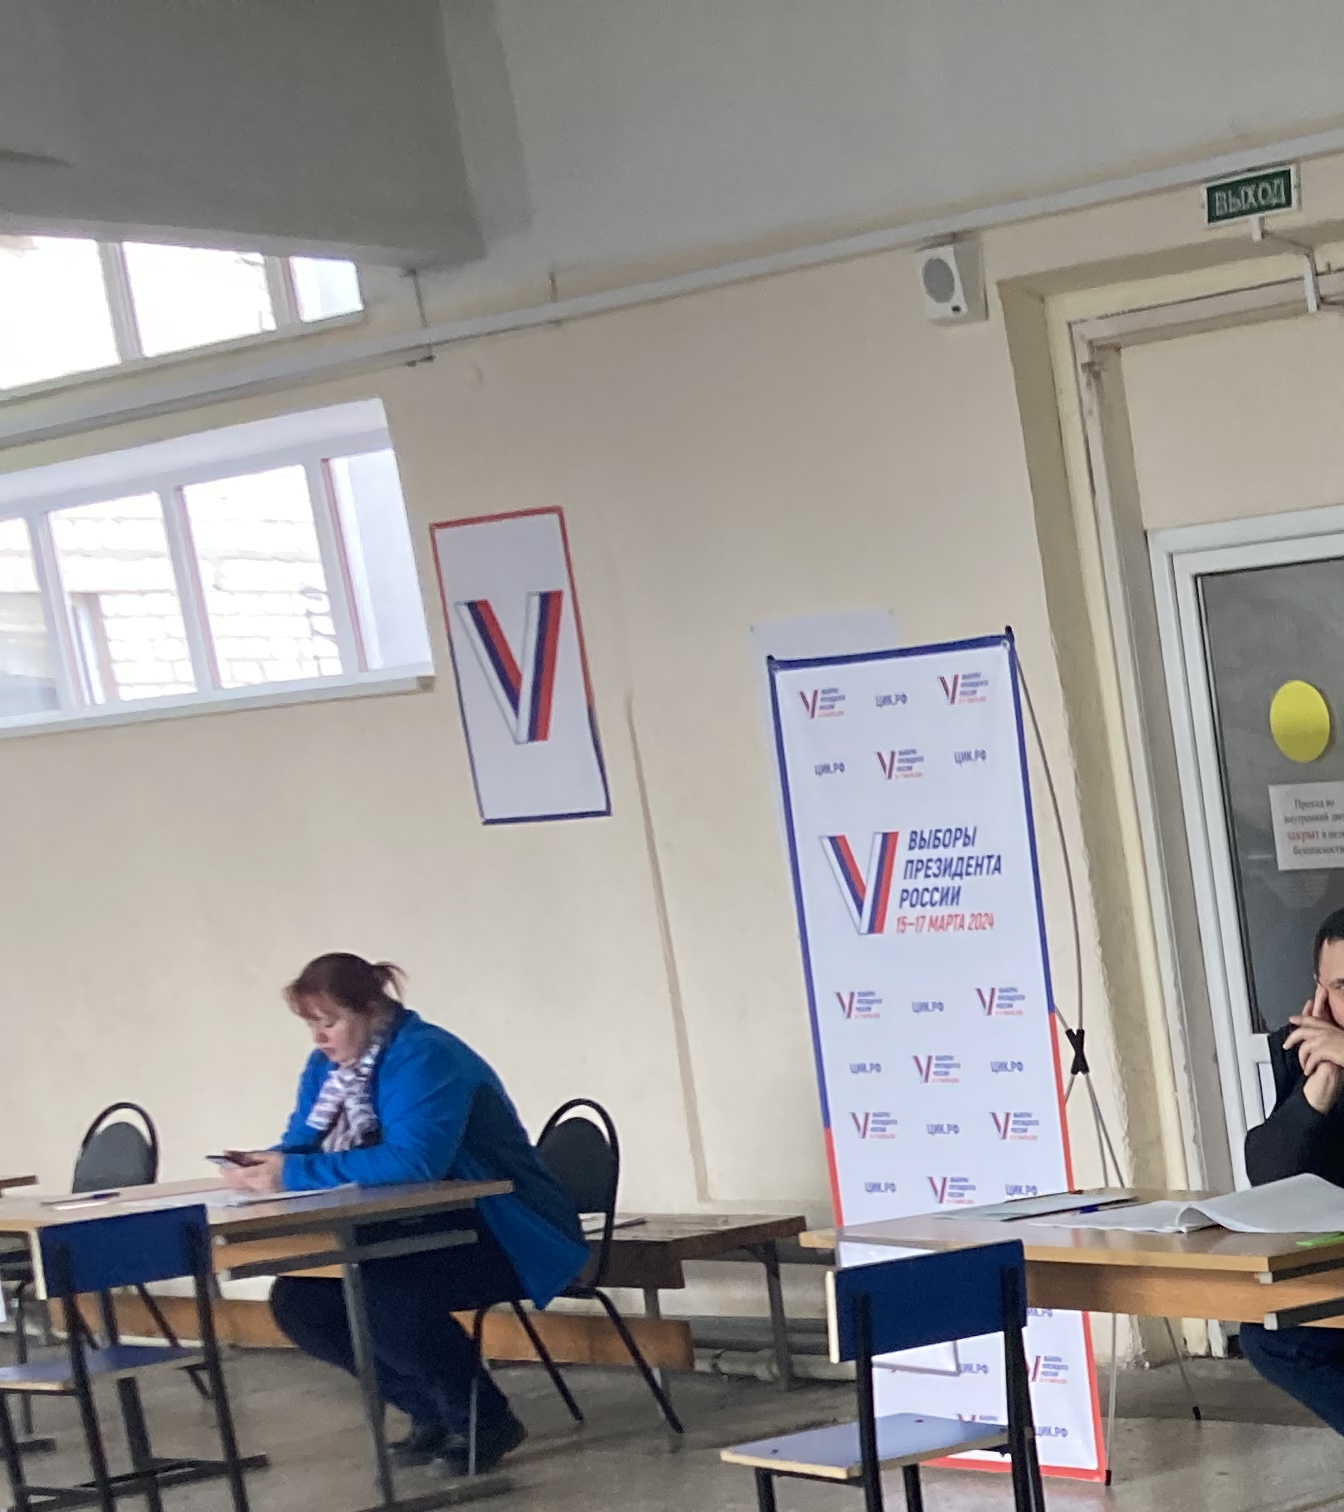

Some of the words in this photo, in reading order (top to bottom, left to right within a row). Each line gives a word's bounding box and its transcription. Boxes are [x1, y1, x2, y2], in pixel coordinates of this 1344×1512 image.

[1215, 177, 1286, 216] ВЫХОД
[954, 749, 987, 765] ЦИК.РФ
[908, 826, 978, 851] ВЫБОРЫ
[903, 854, 1002, 880] ПРЕЗИДЕНТА
[899, 885, 962, 909] РОССИИ
[928, 913, 965, 933] МАРТА
[967, 912, 995, 931] 2024
[912, 1001, 944, 1015] ЦИК.РФ
[990, 1061, 1024, 1074] ЦИК.РФ
[926, 1123, 960, 1136] ЦИК.РФ
[1005, 1183, 1038, 1197] ЦИК.РФ
